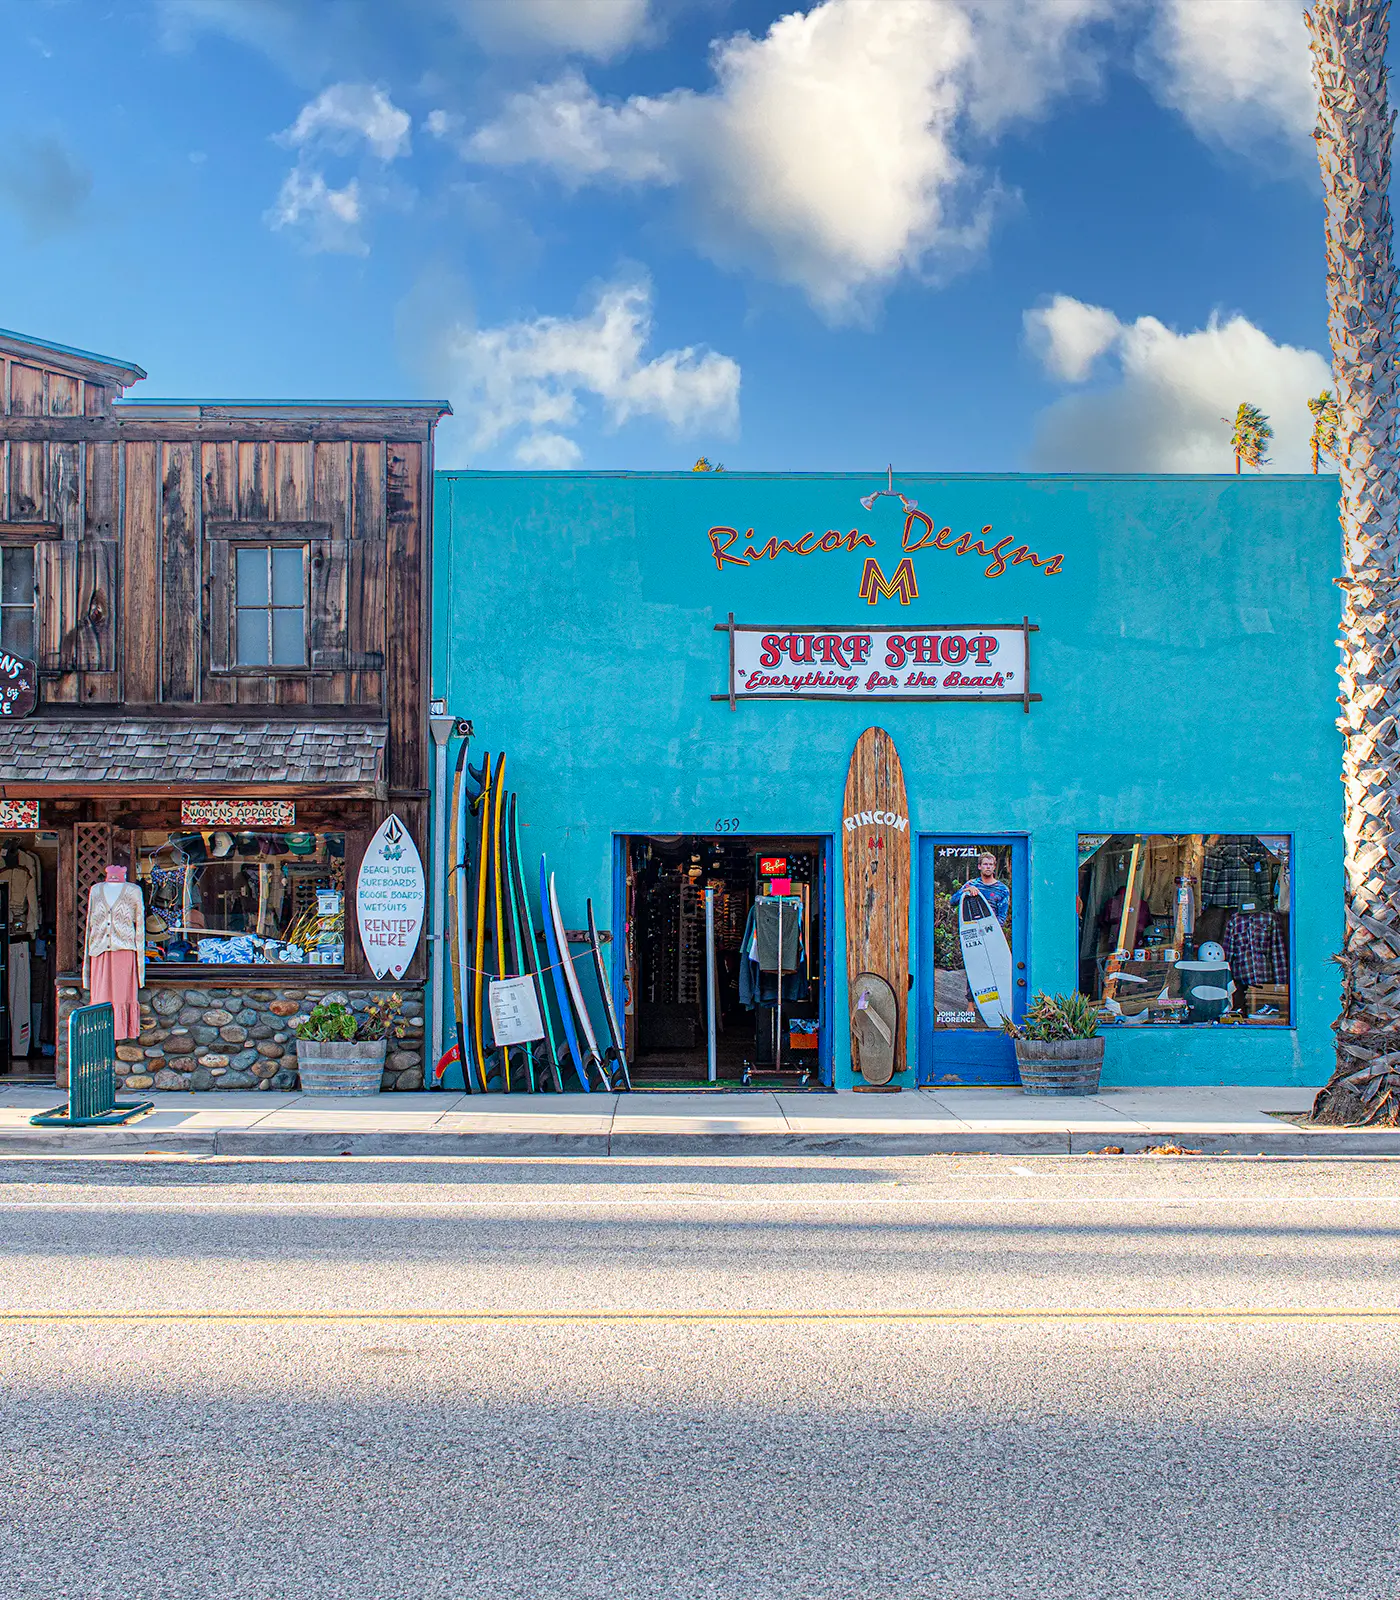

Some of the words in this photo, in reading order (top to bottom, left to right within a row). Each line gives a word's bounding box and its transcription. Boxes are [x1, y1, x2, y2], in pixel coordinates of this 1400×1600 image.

[708, 525, 876, 570] Rincon
[902, 507, 1065, 578] Designs
[759, 634, 873, 671] SURF
[884, 634, 1000, 671] SHOP
[737, 669, 859, 692] "Everything
[865, 671, 899, 690] for
[904, 671, 938, 689] the
[942, 671, 1014, 689] Beach"
[189, 807, 233, 818] WOMENS
[236, 807, 284, 818] APPAREL
[714, 817, 740, 832] 659
[843, 810, 909, 833] RINCON
[946, 848, 980, 857] PYZEL
[363, 866, 390, 874] BEACH
[392, 866, 417, 875] STUFF
[361, 878, 417, 888] SURFBOARDS
[359, 890, 388, 899] BOOGIE
[390, 891, 423, 900] BOARDS
[364, 903, 407, 912] WETSUITS
[364, 919, 416, 933] RENTED
[369, 933, 407, 947] HERE
